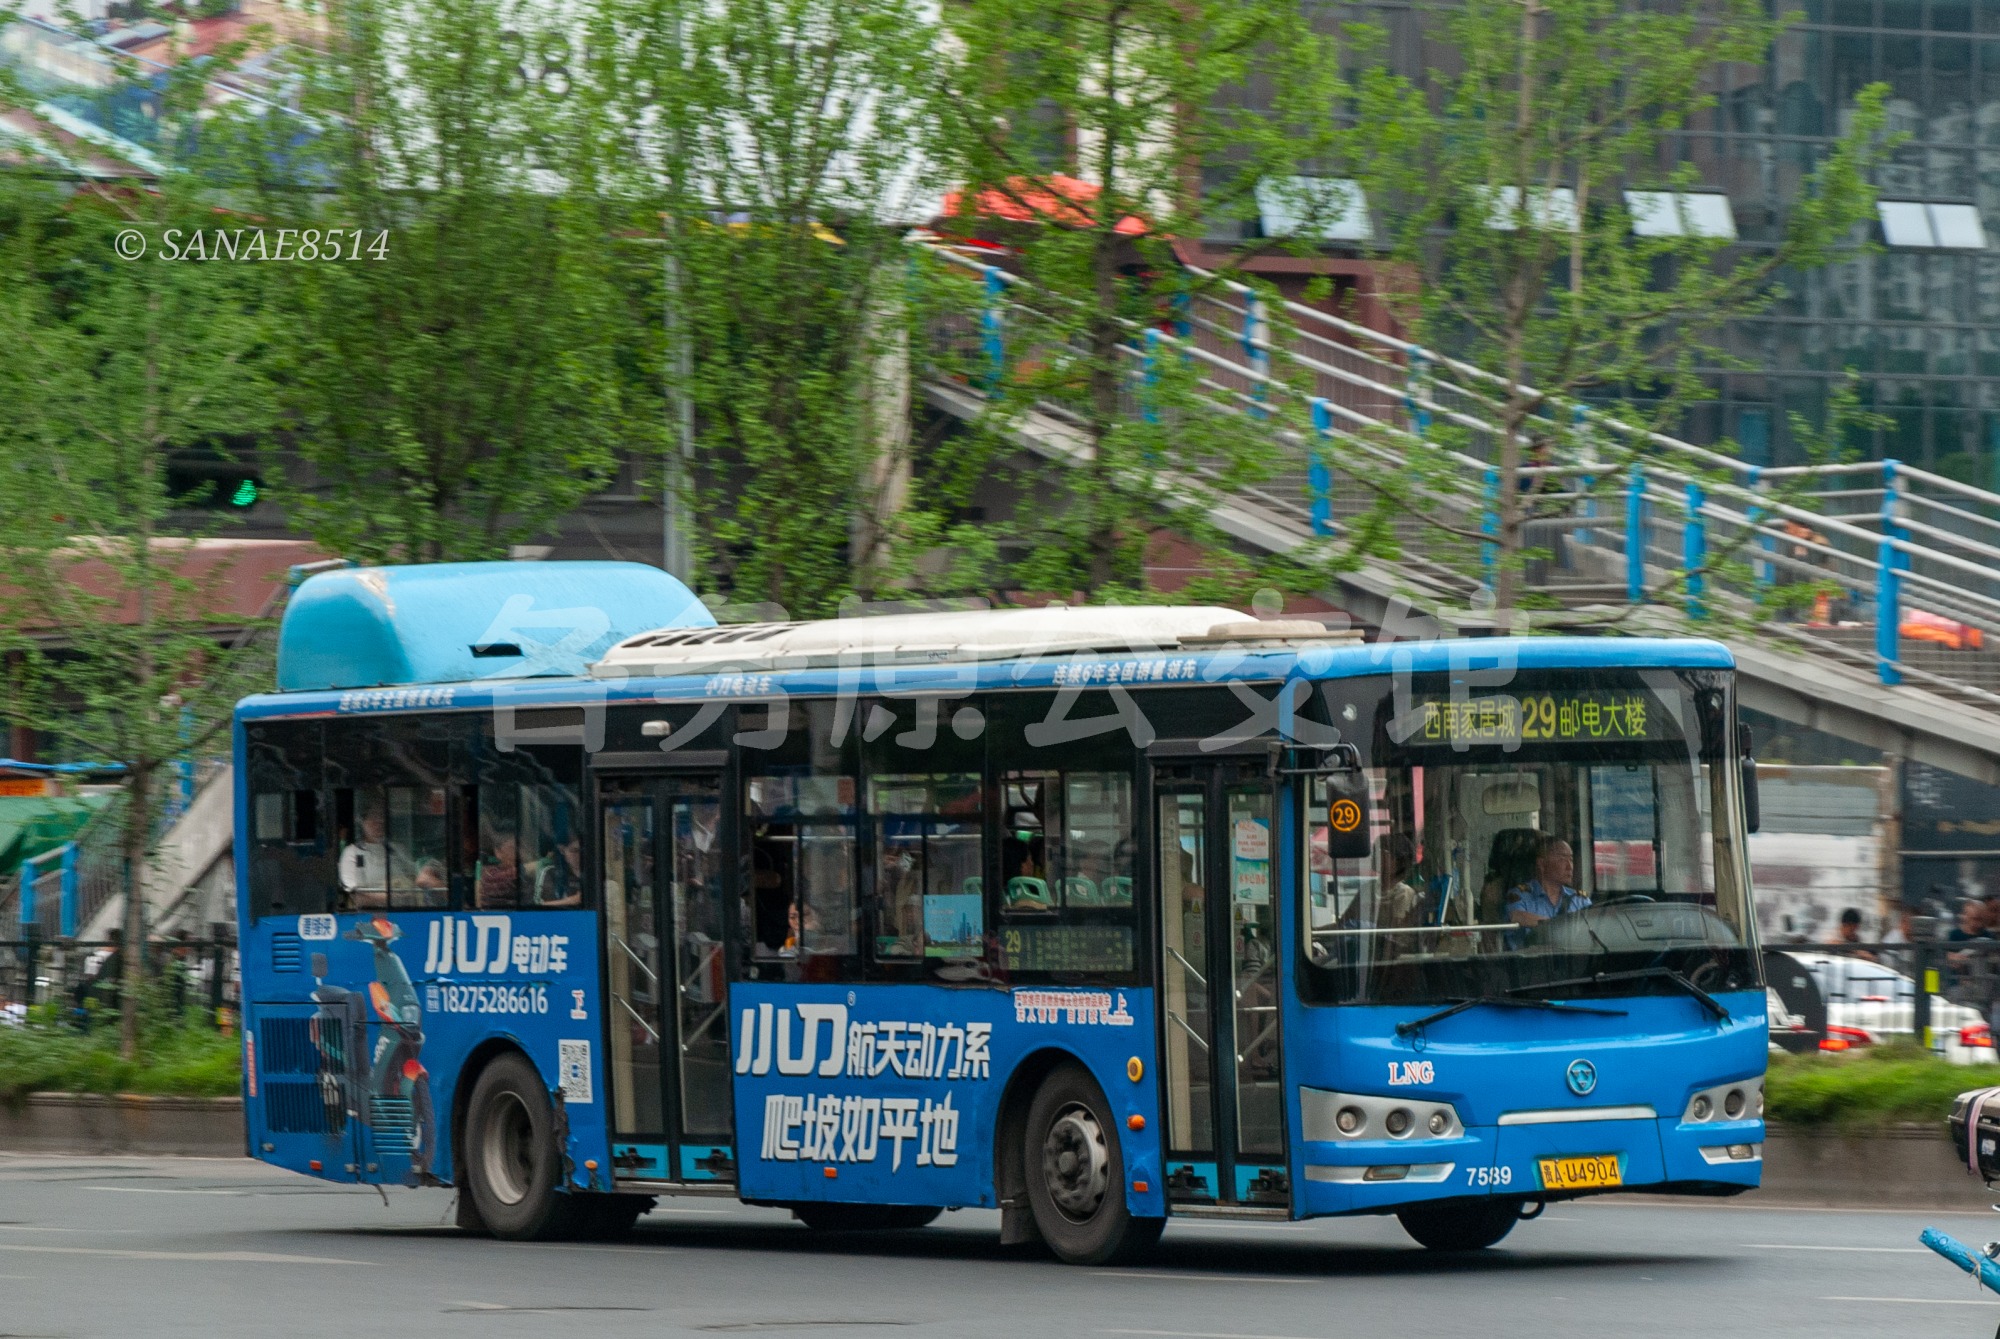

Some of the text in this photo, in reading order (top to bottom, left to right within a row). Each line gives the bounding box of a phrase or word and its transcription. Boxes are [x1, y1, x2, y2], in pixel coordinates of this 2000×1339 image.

[1424, 696, 1648, 739] 西南家居城 29 邮电大楼
[1334, 806, 1355, 825] 29
[425, 915, 569, 974] 小刀 电动车
[441, 985, 549, 1014] 18275286616
[736, 1003, 992, 1079] 小刀 航天动力系
[1388, 1061, 1435, 1085] LNG
[760, 1090, 959, 1174] 爬坡如平地
[1466, 1166, 1512, 1186] 7589
